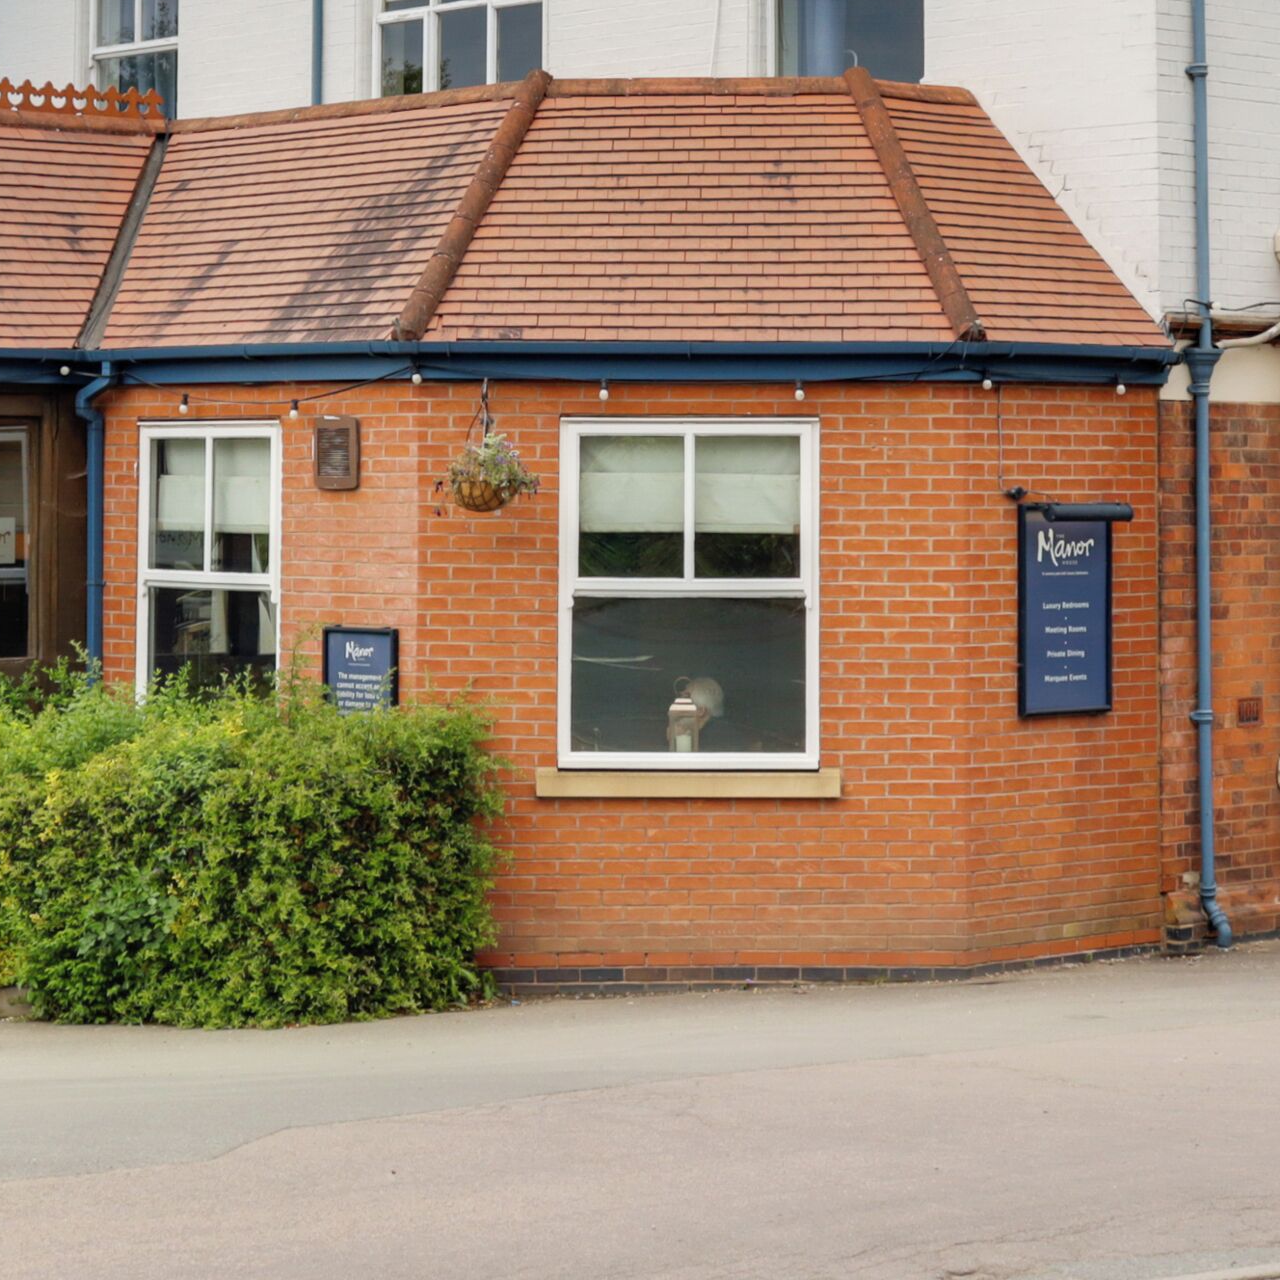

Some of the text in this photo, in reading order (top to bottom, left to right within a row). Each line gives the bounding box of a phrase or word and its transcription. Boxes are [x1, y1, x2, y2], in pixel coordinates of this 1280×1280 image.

[1037, 528, 1094, 567] Manor
[1042, 601, 1089, 610] Luxury Bedrooms
[1045, 625, 1087, 634] Meeting Rooms
[345, 641, 374, 661] Manor
[1046, 650, 1085, 658] Private Dining
